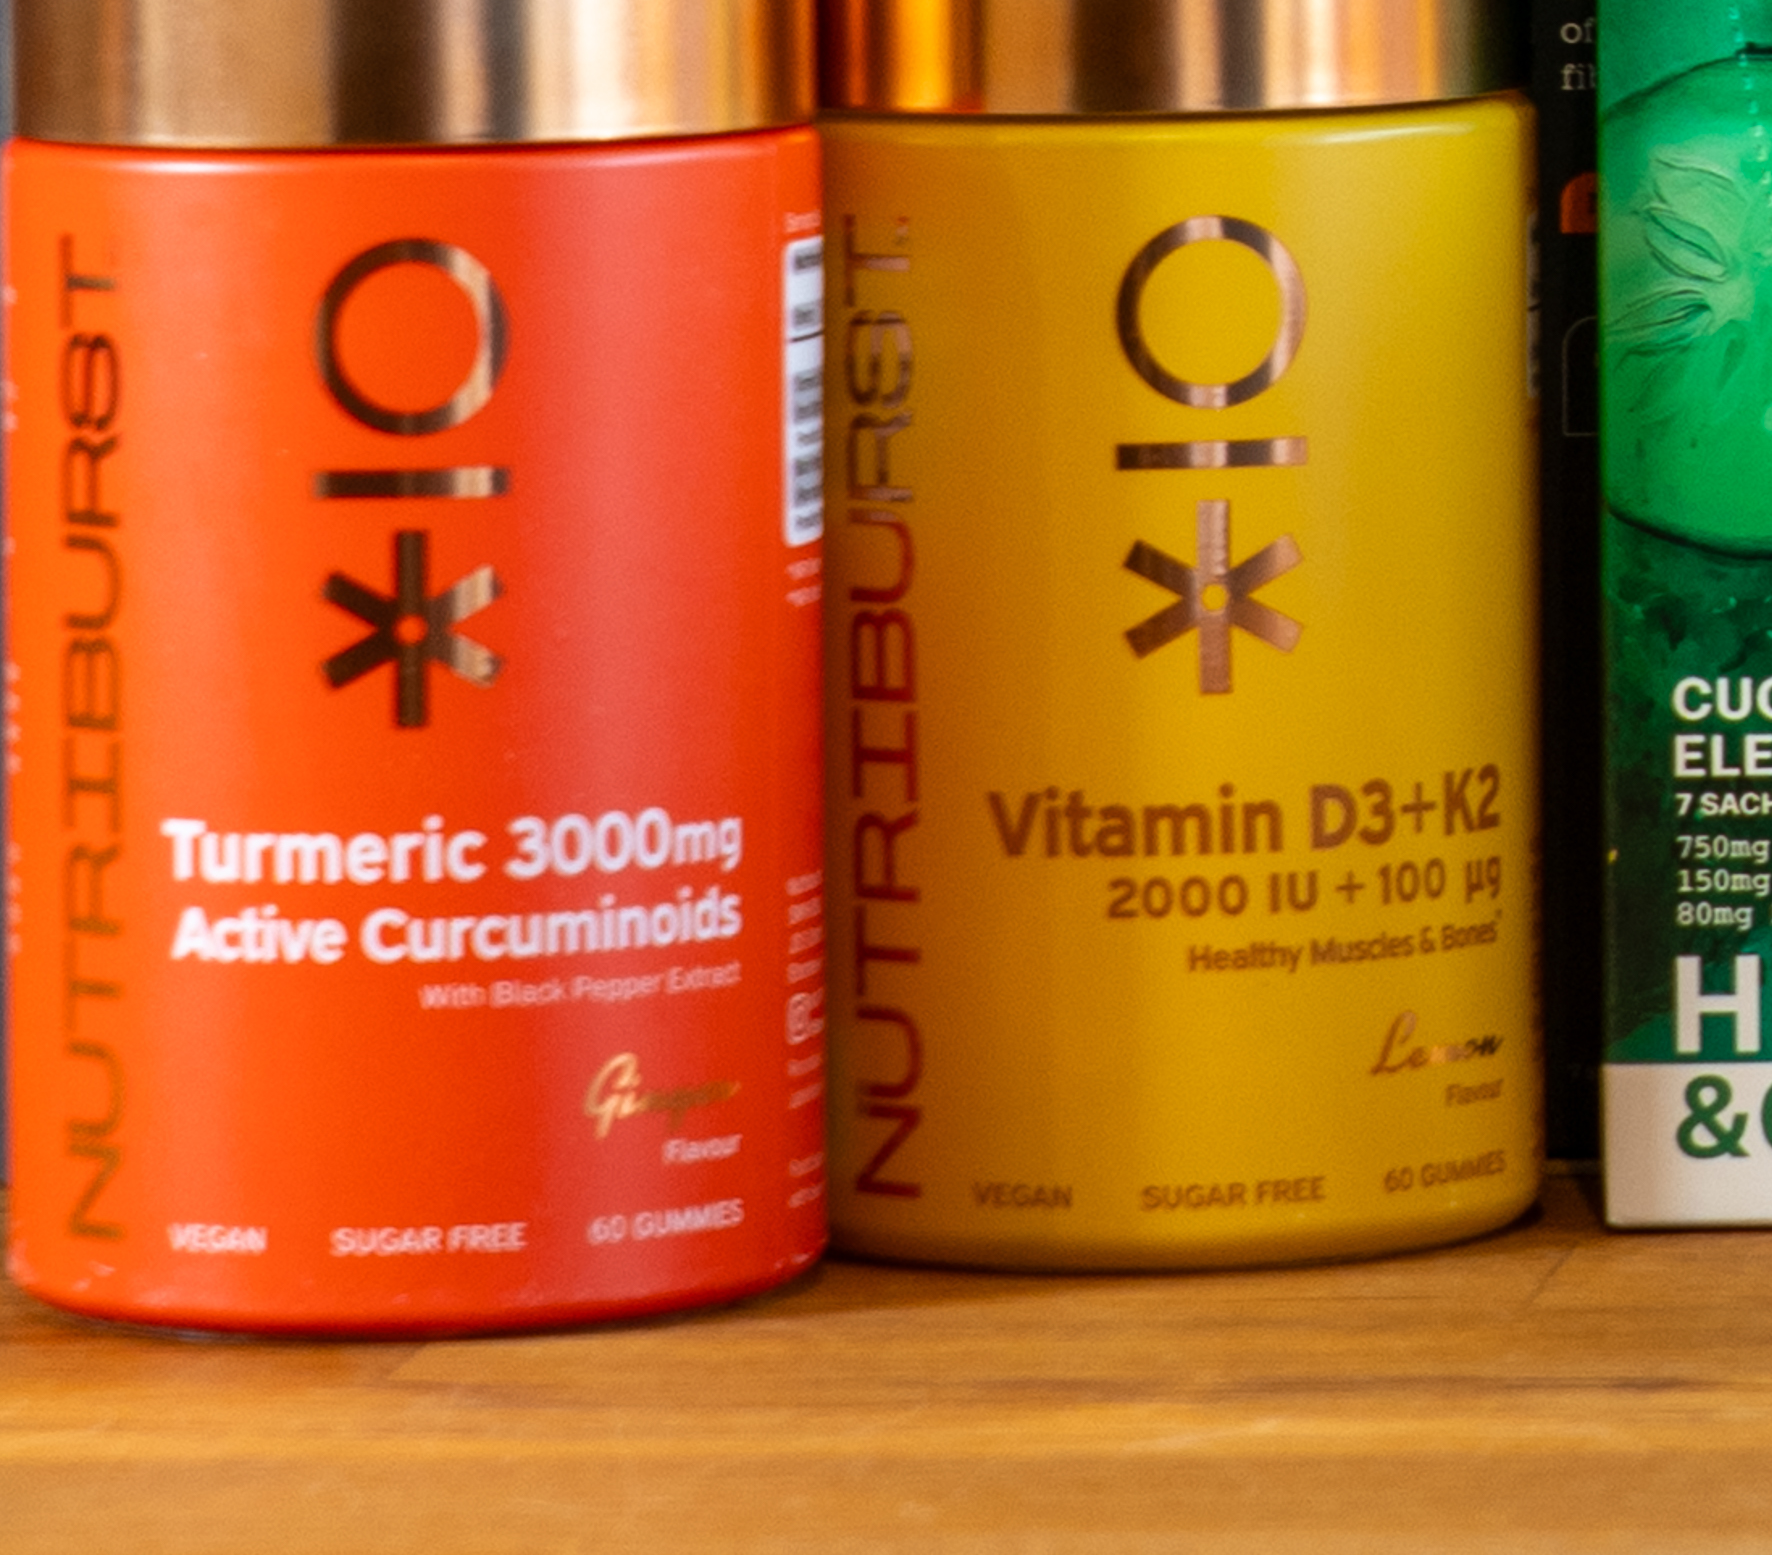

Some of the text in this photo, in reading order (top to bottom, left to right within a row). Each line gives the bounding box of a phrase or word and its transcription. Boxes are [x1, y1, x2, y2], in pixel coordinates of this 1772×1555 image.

[56, 231, 124, 1243] NUTRIBURST
[987, 763, 1500, 858] Vitamin D3+K2
[162, 807, 742, 885] Turmeric 3000mg
[1676, 835, 1771, 864] 750mg
[1106, 858, 1446, 920] 2000 100
[1677, 868, 1772, 898] 150mg
[171, 906, 347, 963] Active
[361, 886, 742, 963] Curcuminoids
[1676, 901, 1754, 931] 80mg
[1189, 932, 1415, 973] Healthy Muscles
[419, 962, 742, 1009] With Black Pepper Extract
[1420, 1150, 1507, 1190] GUMMIES
[971, 1179, 1072, 1209] VEGAN
[1141, 1177, 1326, 1213] SUGAR FREE
[167, 1222, 267, 1254] VEGAN
[331, 1222, 528, 1256] SUGAR FREE
[635, 1199, 743, 1240] GUMMIES
